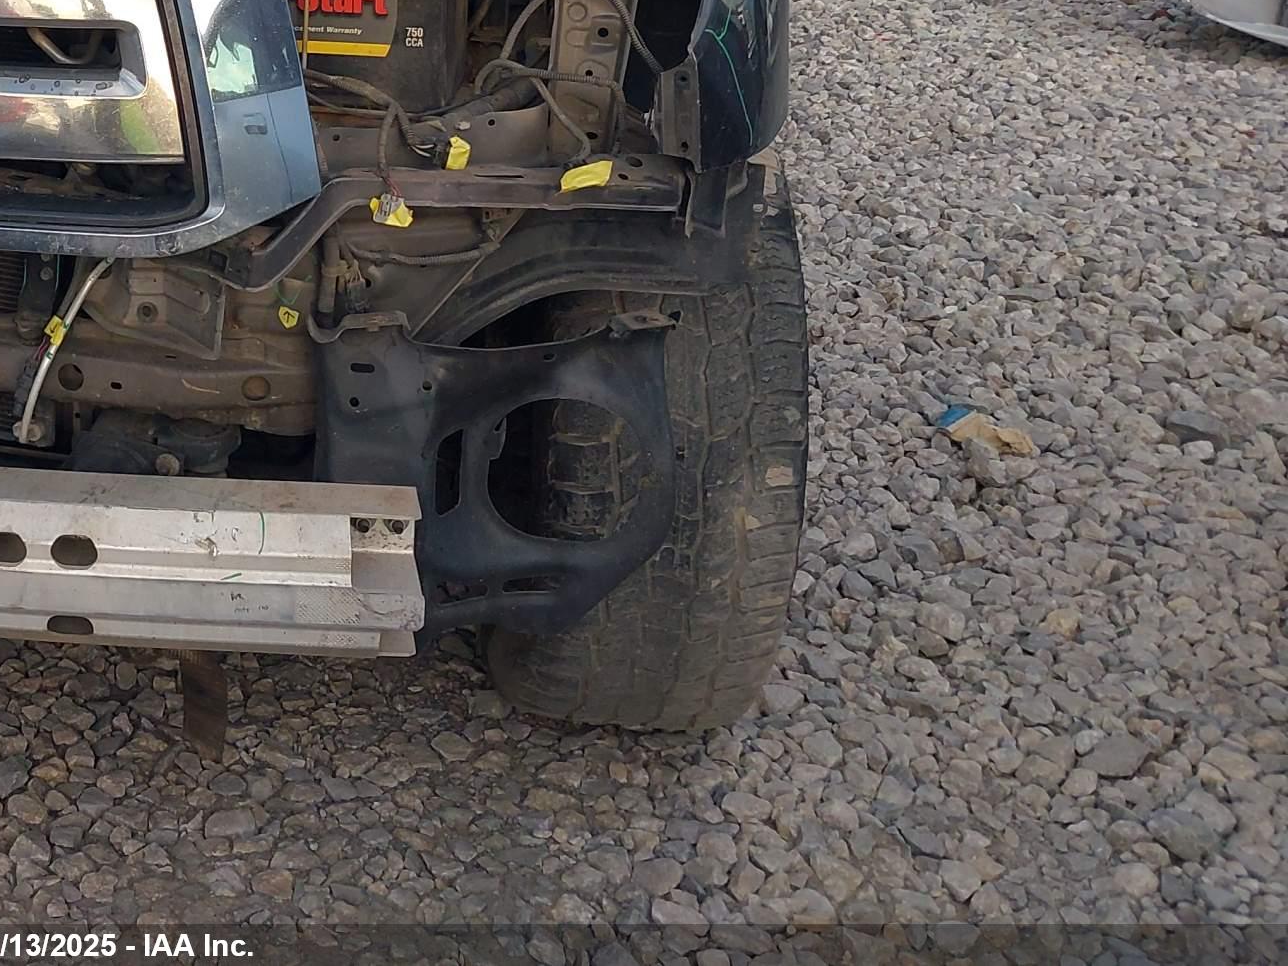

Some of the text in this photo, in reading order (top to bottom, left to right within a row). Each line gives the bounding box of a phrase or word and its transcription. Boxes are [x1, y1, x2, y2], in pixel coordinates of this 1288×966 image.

[326, 26, 362, 35] Warranty
[406, 27, 424, 38] 750
[405, 37, 424, 48] CCA
